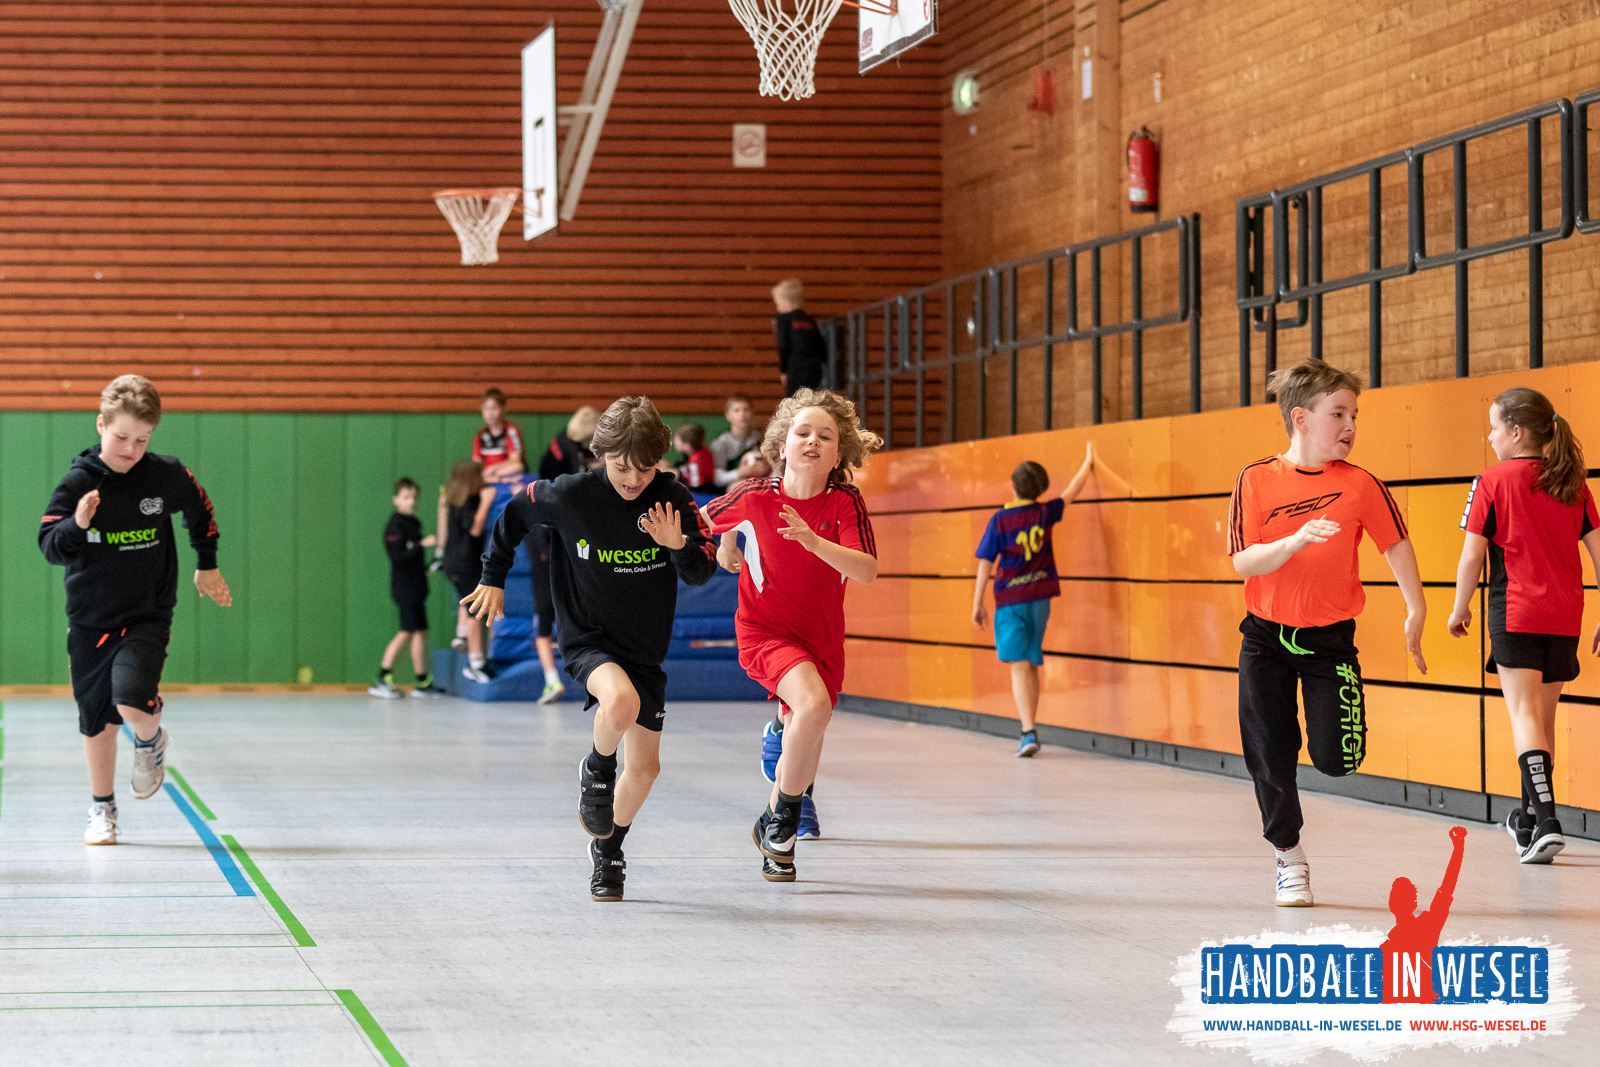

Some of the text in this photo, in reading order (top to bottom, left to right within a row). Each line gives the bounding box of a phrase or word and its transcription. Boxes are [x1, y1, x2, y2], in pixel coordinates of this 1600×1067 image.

[106, 528, 157, 544] wesser
[1015, 525, 1045, 561] 10
[597, 547, 660, 564] wesser
